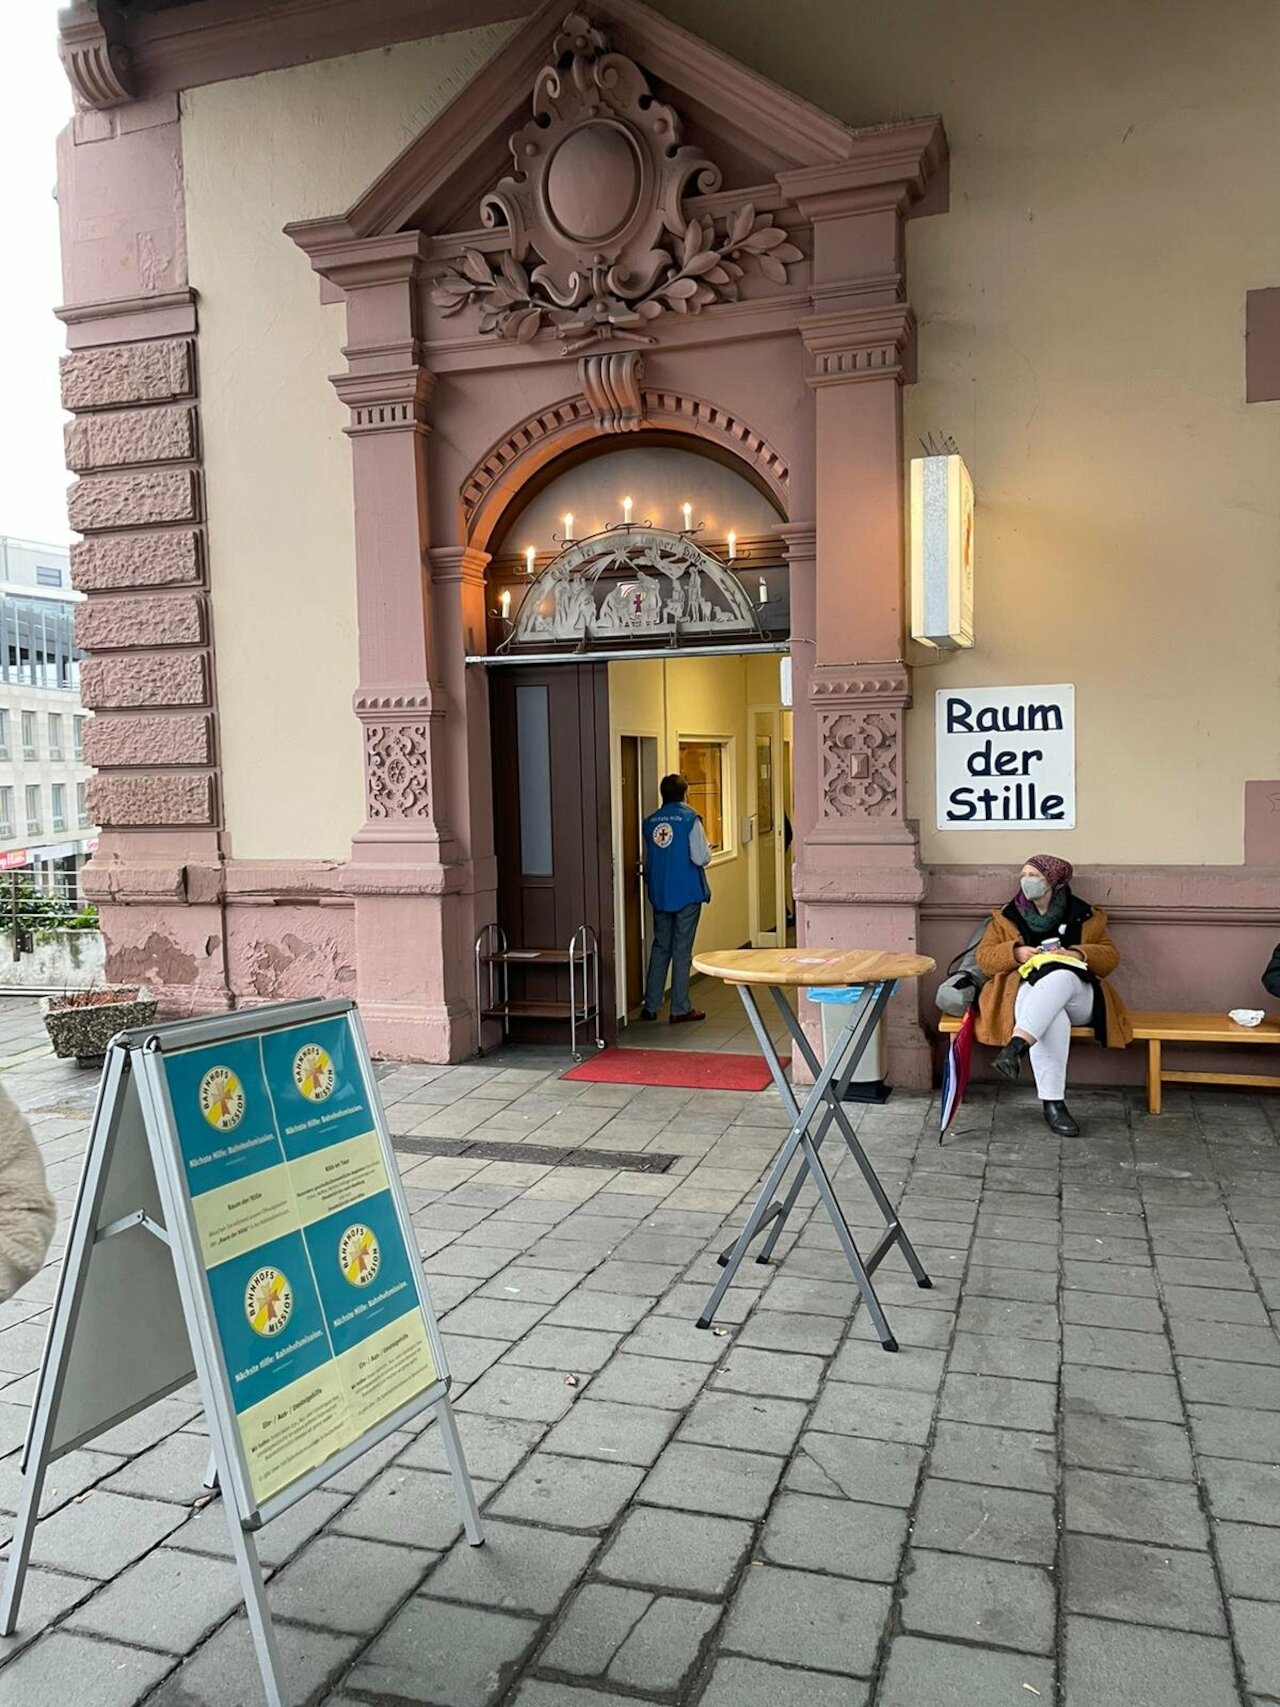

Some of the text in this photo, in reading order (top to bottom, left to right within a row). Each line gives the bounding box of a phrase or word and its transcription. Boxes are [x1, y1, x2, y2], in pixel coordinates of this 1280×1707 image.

[947, 698, 1063, 734] Raum
[967, 739, 1042, 777] der
[946, 783, 1065, 821] Stille
[296, 1047, 320, 1083] BAHNHOFS
[315, 1069, 333, 1099] MISSION
[202, 1069, 229, 1110] BAHNHOFS
[222, 1094, 243, 1128] MISSION
[341, 1228, 364, 1269] BAHNHOFS
[360, 1248, 379, 1283] MISSION
[247, 1270, 275, 1317] BAHNHOFS
[268, 1293, 291, 1333] MISSION
